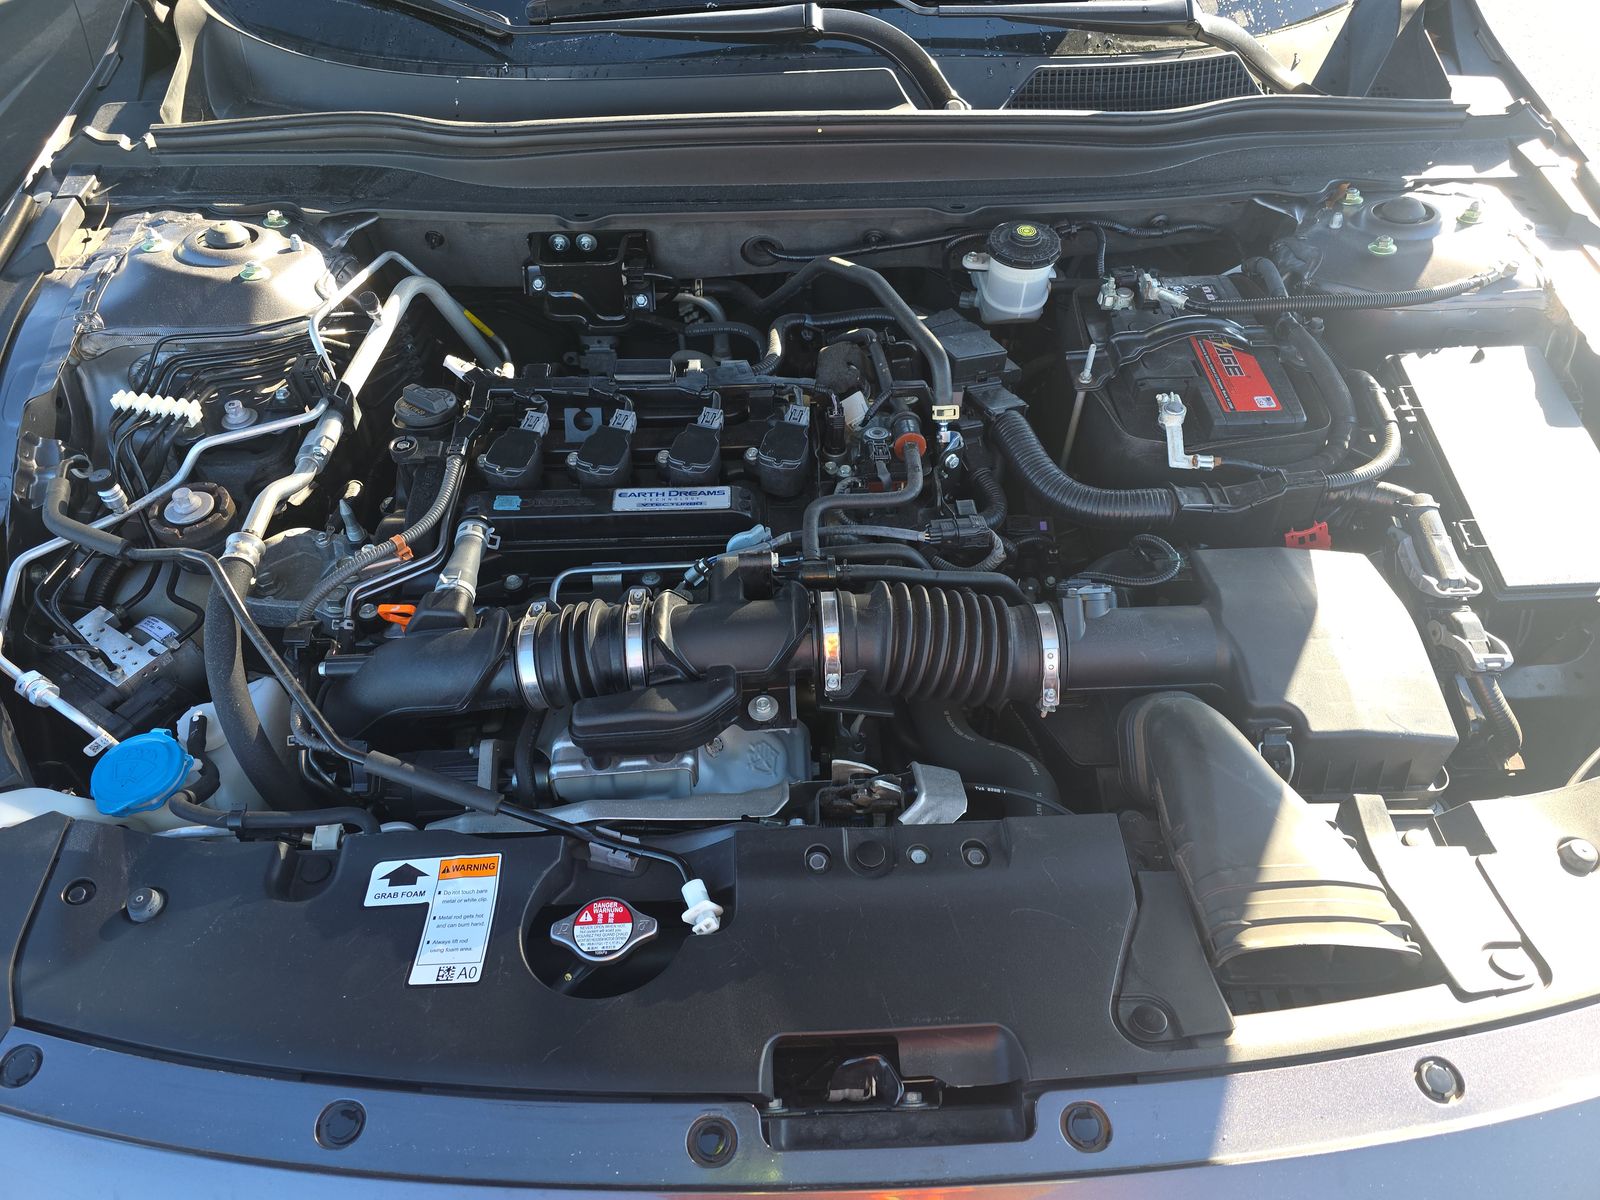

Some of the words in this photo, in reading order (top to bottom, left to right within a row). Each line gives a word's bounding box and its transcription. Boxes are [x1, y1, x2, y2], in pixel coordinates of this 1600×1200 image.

[451, 862, 496, 873] WARNING
[374, 892, 399, 900] GRAB
[401, 890, 426, 898] FOAM
